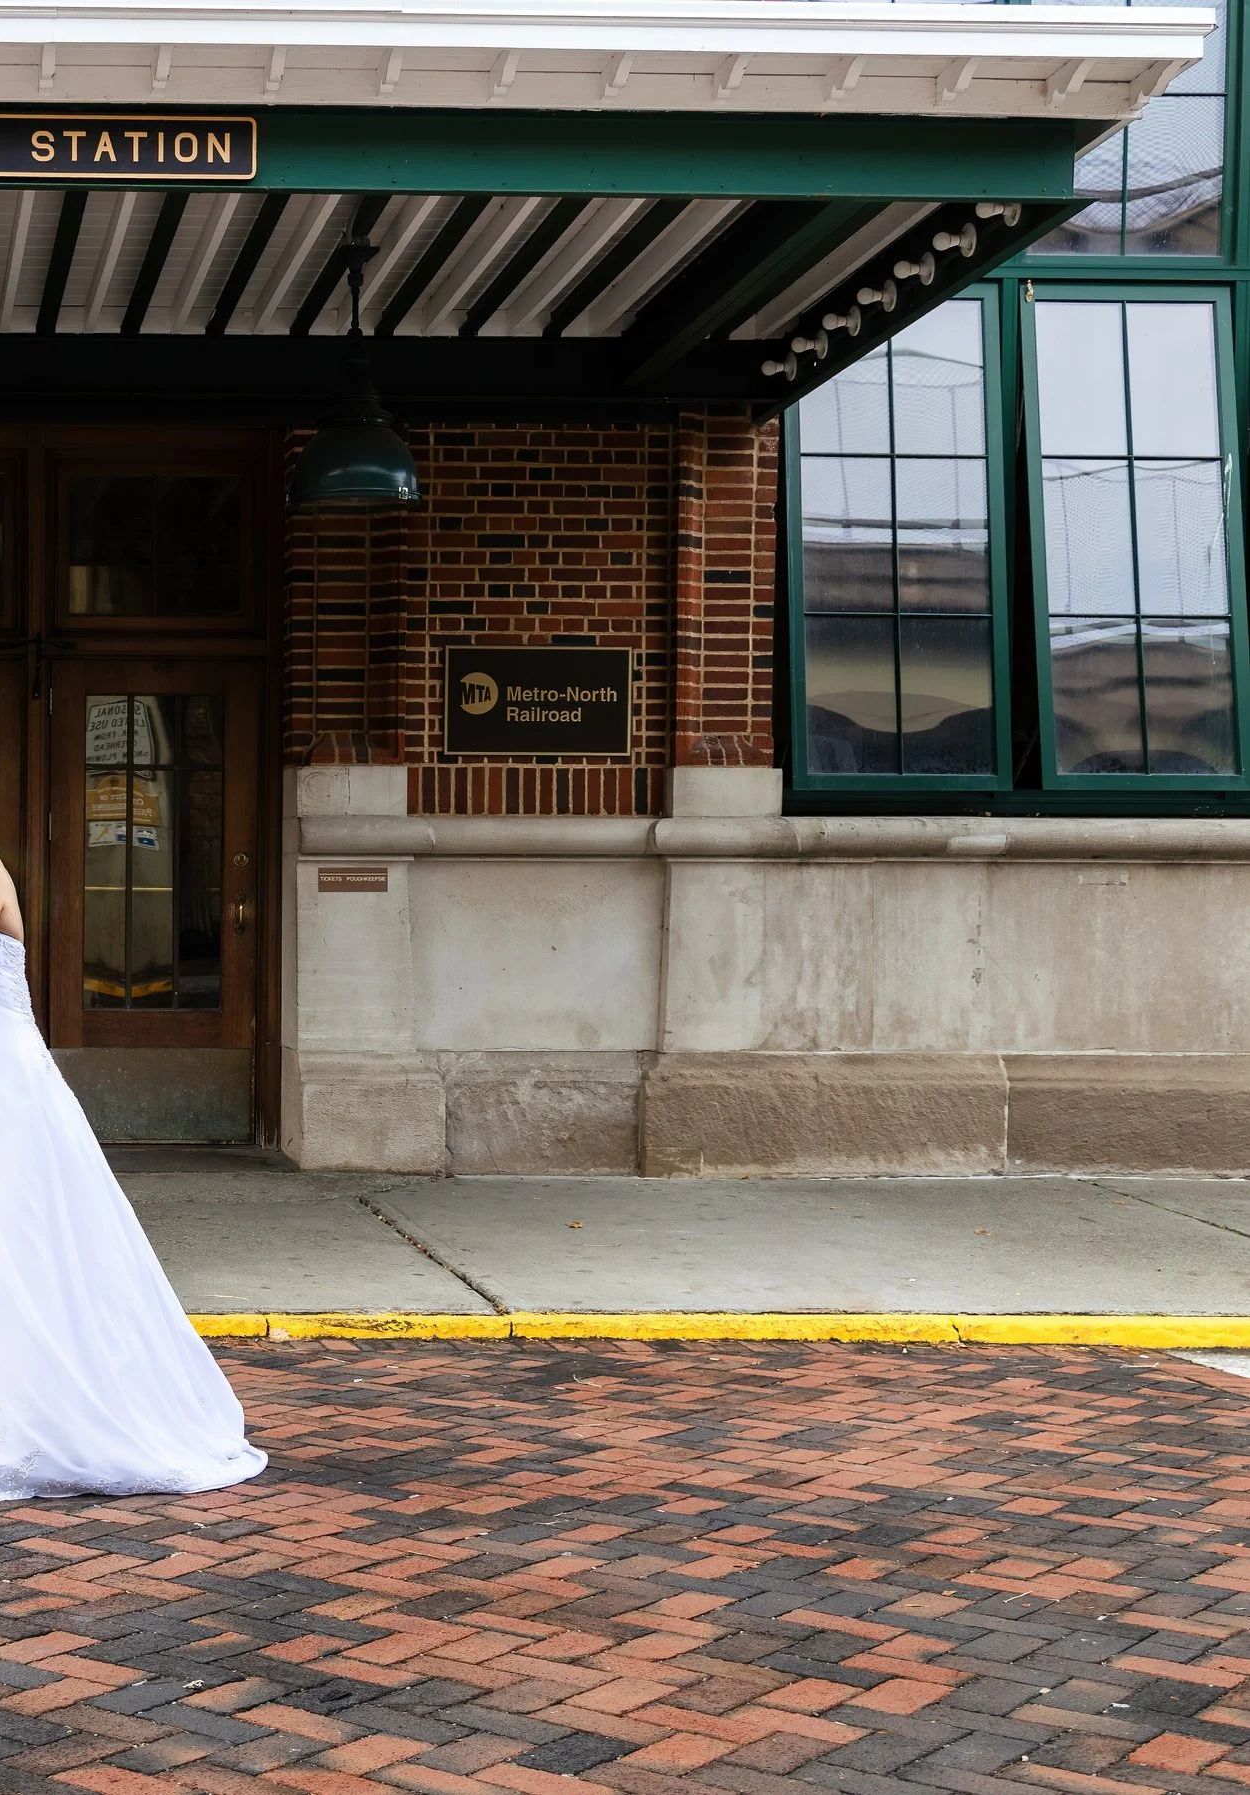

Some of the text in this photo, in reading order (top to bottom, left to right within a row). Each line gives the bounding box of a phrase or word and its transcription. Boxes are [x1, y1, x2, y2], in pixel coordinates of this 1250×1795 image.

[31, 128, 231, 164] STATION
[460, 682, 492, 705] MTA
[506, 686, 618, 702] Metro-North
[506, 707, 582, 722] Railroad
